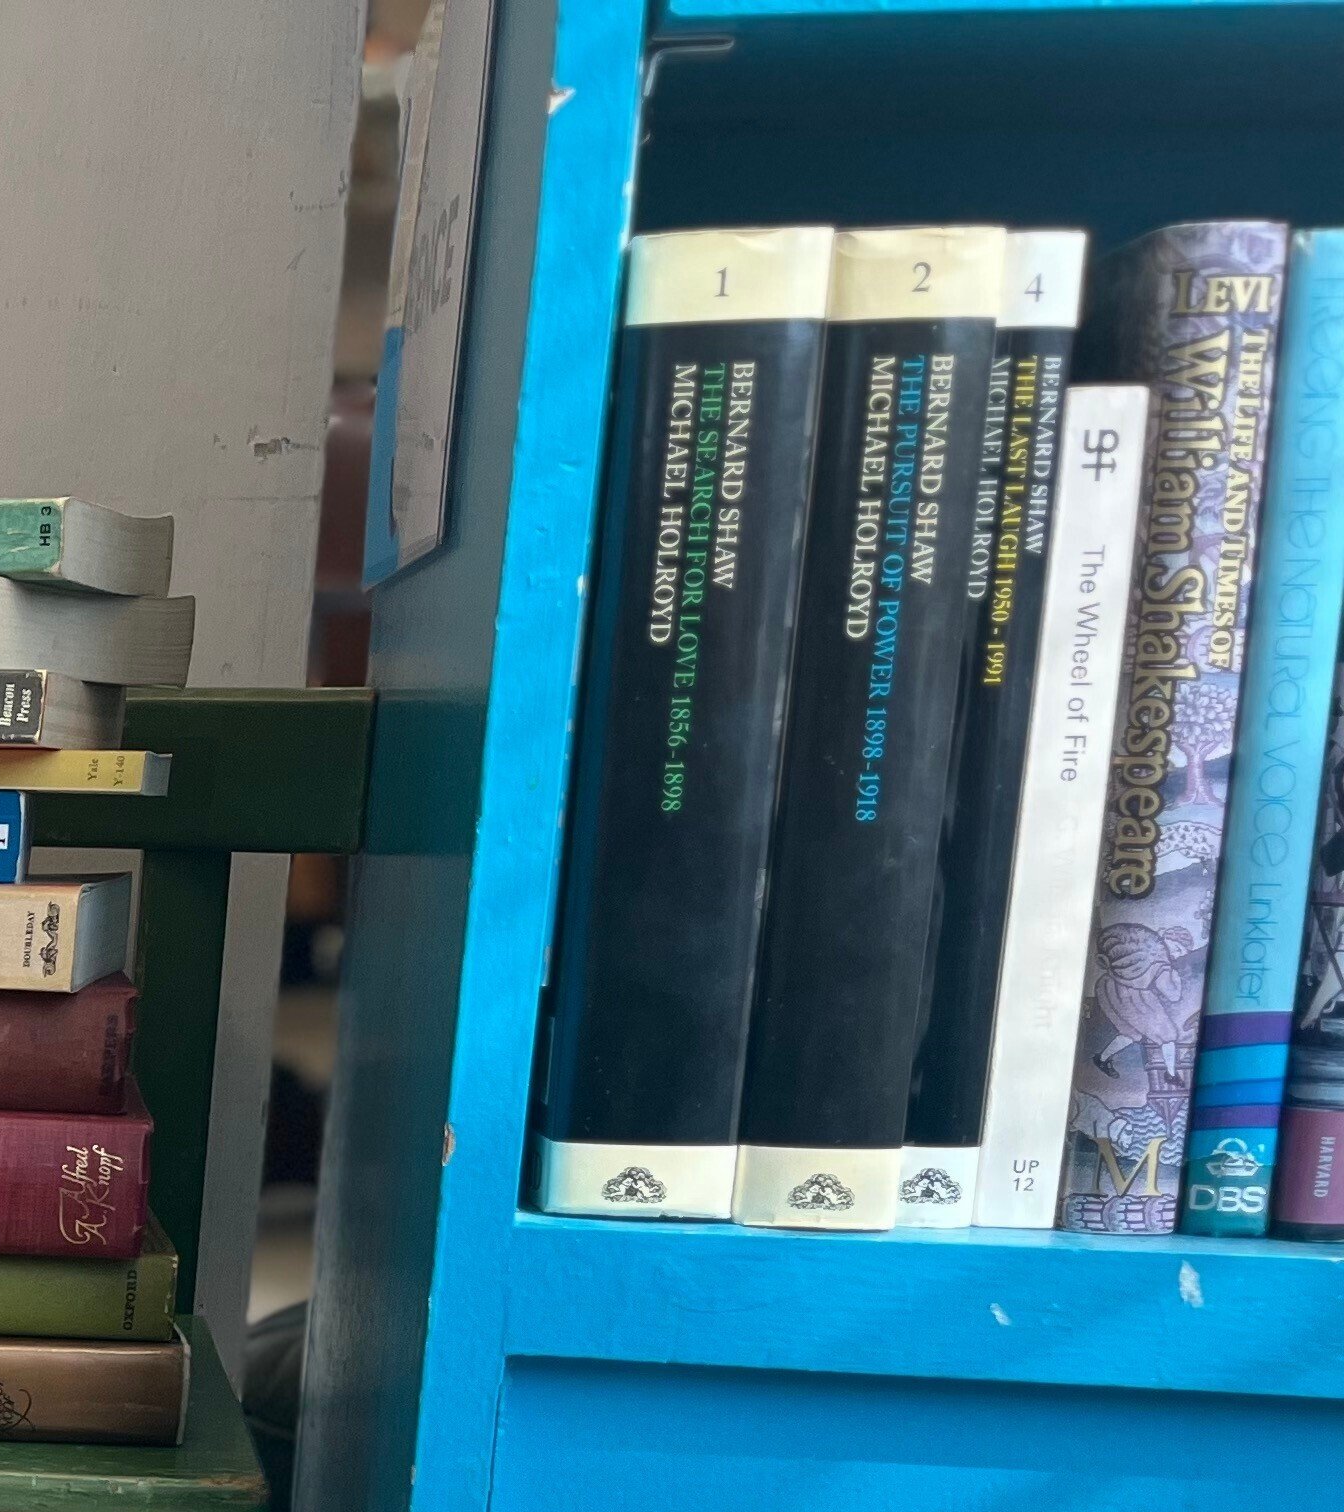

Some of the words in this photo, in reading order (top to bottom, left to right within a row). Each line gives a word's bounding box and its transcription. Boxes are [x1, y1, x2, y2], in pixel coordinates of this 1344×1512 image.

[714, 266, 729, 297] 1
[912, 261, 932, 292] 2
[1024, 272, 1044, 302] 4
[1169, 270, 1276, 318] LEVI
[699, 361, 726, 422] THE
[898, 354, 925, 415] THE
[1014, 355, 1038, 408] THE
[663, 363, 697, 498] MICHAEL
[721, 360, 756, 500] BERNARD
[861, 356, 896, 492] MICHAEL
[920, 354, 955, 494] BERNARD
[981, 357, 1011, 472] MICHAEL
[1033, 357, 1062, 478] BERNARD
[1148, 329, 1231, 554] William
[1006, 417, 1032, 478] LAST
[40, 505, 52, 517] 3
[688, 430, 720, 542] SEARCH
[886, 423, 919, 546] PURSUIT
[39, 523, 52, 547] HB
[712, 506, 741, 590] SHAW
[911, 502, 940, 585] SHAW
[968, 479, 998, 599] HOLROYD
[997, 485, 1025, 570] LAUGH
[1025, 484, 1050, 554] SHAW
[649, 506, 683, 643] HOLROYD
[681, 551, 707, 607] FOR
[846, 500, 882, 639] HOLROYD
[881, 554, 904, 592] OF
[1079, 544, 1106, 594] The
[992, 578, 1013, 622] 1950
[673, 615, 701, 689] LOVE
[869, 600, 900, 699] POWER
[984, 643, 1005, 684] 1991
[1070, 602, 1100, 686] Wheel
[1208, 630, 1234, 669] OF
[16, 688, 32, 723] Press
[1067, 697, 1090, 723] of
[1110, 563, 1205, 896] Shakespeare
[87, 757, 99, 781] Yale
[113, 755, 126, 786] Y-140
[1060, 735, 1087, 783] Fire
[23, 911, 35, 968] DOUBLEDAY
[1237, 883, 1282, 1006] Linklater
[1012, 1159, 1040, 1174] UP
[1013, 1177, 1035, 1192] 12
[1089, 1134, 1168, 1197] M
[1313, 1136, 1337, 1198] HARVARD
[1189, 1184, 1267, 1214] DBS
[123, 1269, 138, 1331] OXFORD
